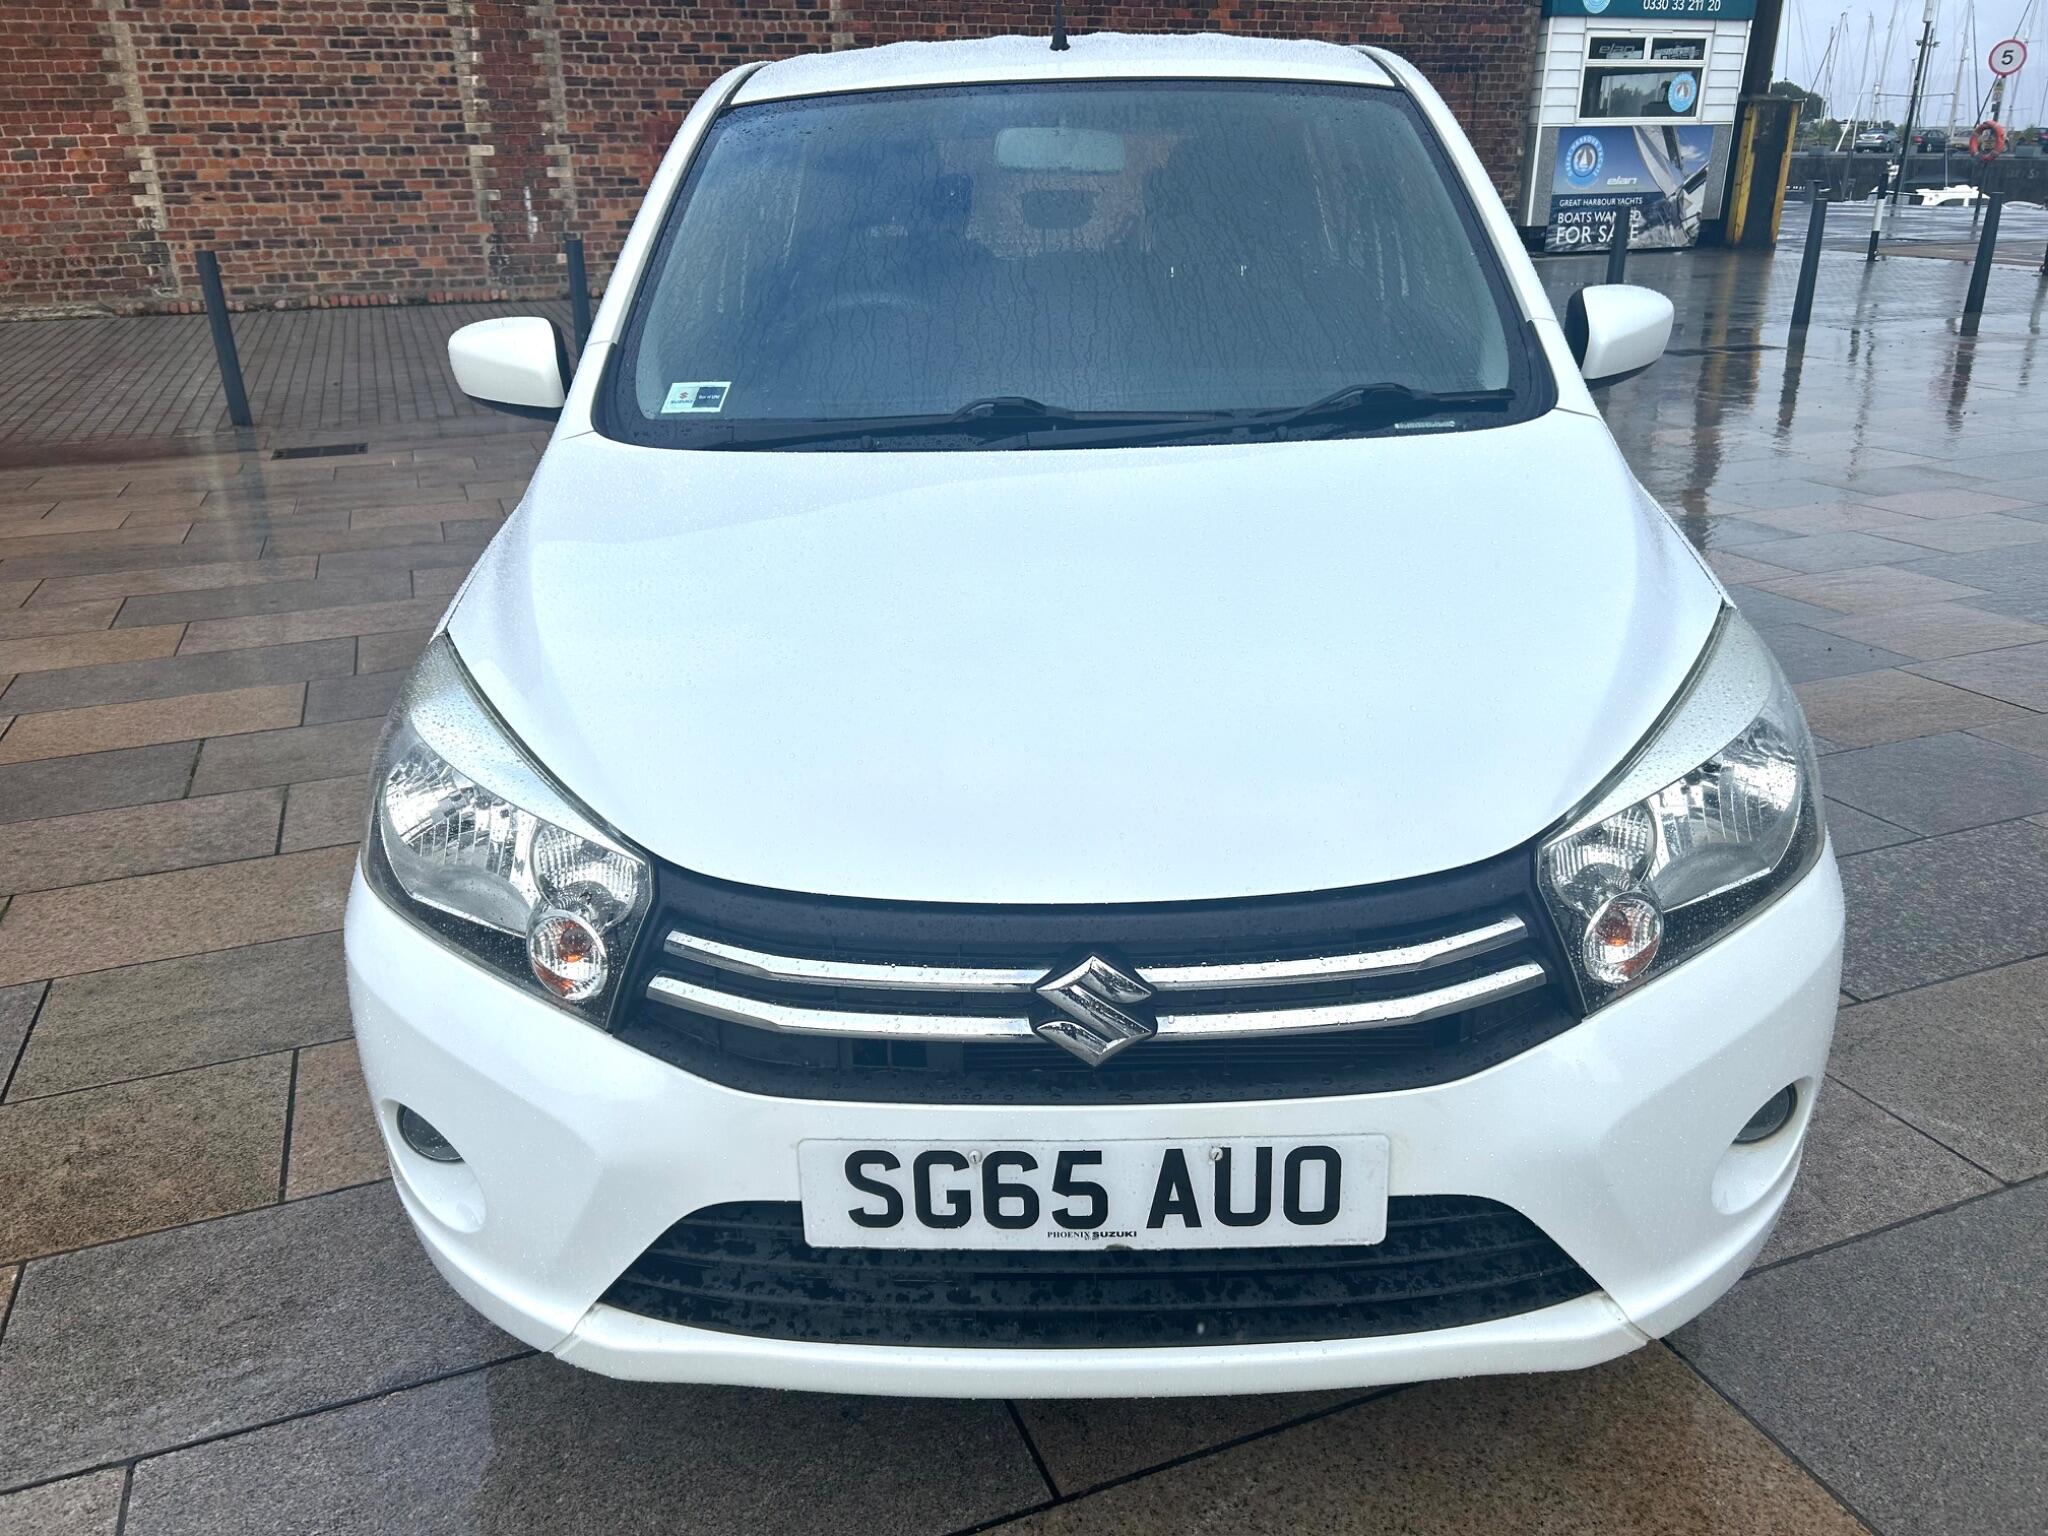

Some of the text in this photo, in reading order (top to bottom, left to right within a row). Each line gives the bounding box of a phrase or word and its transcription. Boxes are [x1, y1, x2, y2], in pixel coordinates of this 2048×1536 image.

[1643, 0, 1668, 10] 0330
[1671, 0, 1685, 10] 33
[1707, 0, 1721, 11] 20
[2001, 50, 2015, 65] 5
[1607, 175, 1637, 185] elan
[1559, 196, 1643, 207] GREAT HARBOUR YACHTS
[1557, 211, 1592, 224] BOATS
[1556, 224, 1639, 245] FOR SAE
[844, 1145, 1342, 1230] SG65 AUO
[1047, 1231, 1091, 1240] PHOENIX
[1092, 1231, 1137, 1239] SUZUKI
